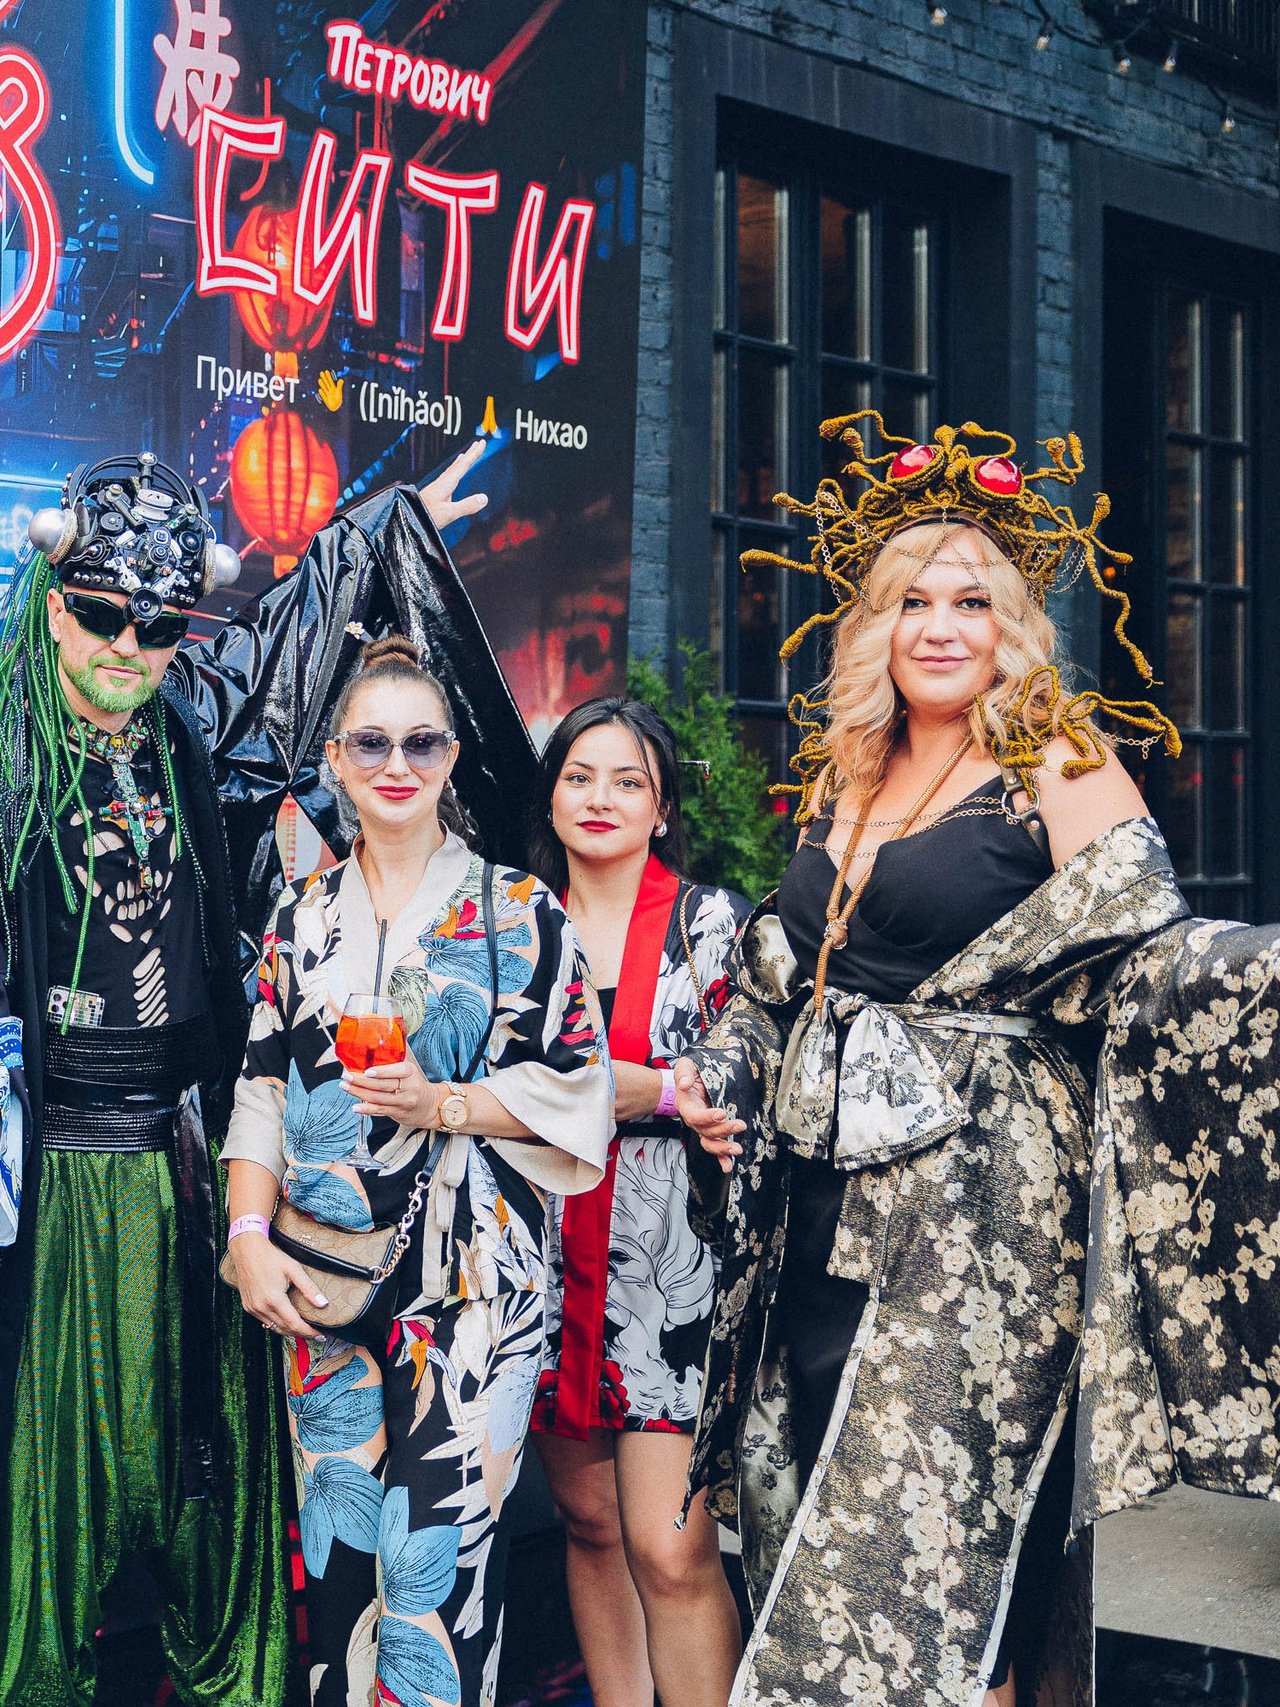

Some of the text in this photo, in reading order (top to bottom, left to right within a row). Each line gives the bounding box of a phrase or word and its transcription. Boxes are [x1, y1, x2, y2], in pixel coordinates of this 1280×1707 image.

[197, 109, 593, 361] СИТИ
[196, 355, 300, 403] Привет
[515, 409, 588, 450] Нихао
